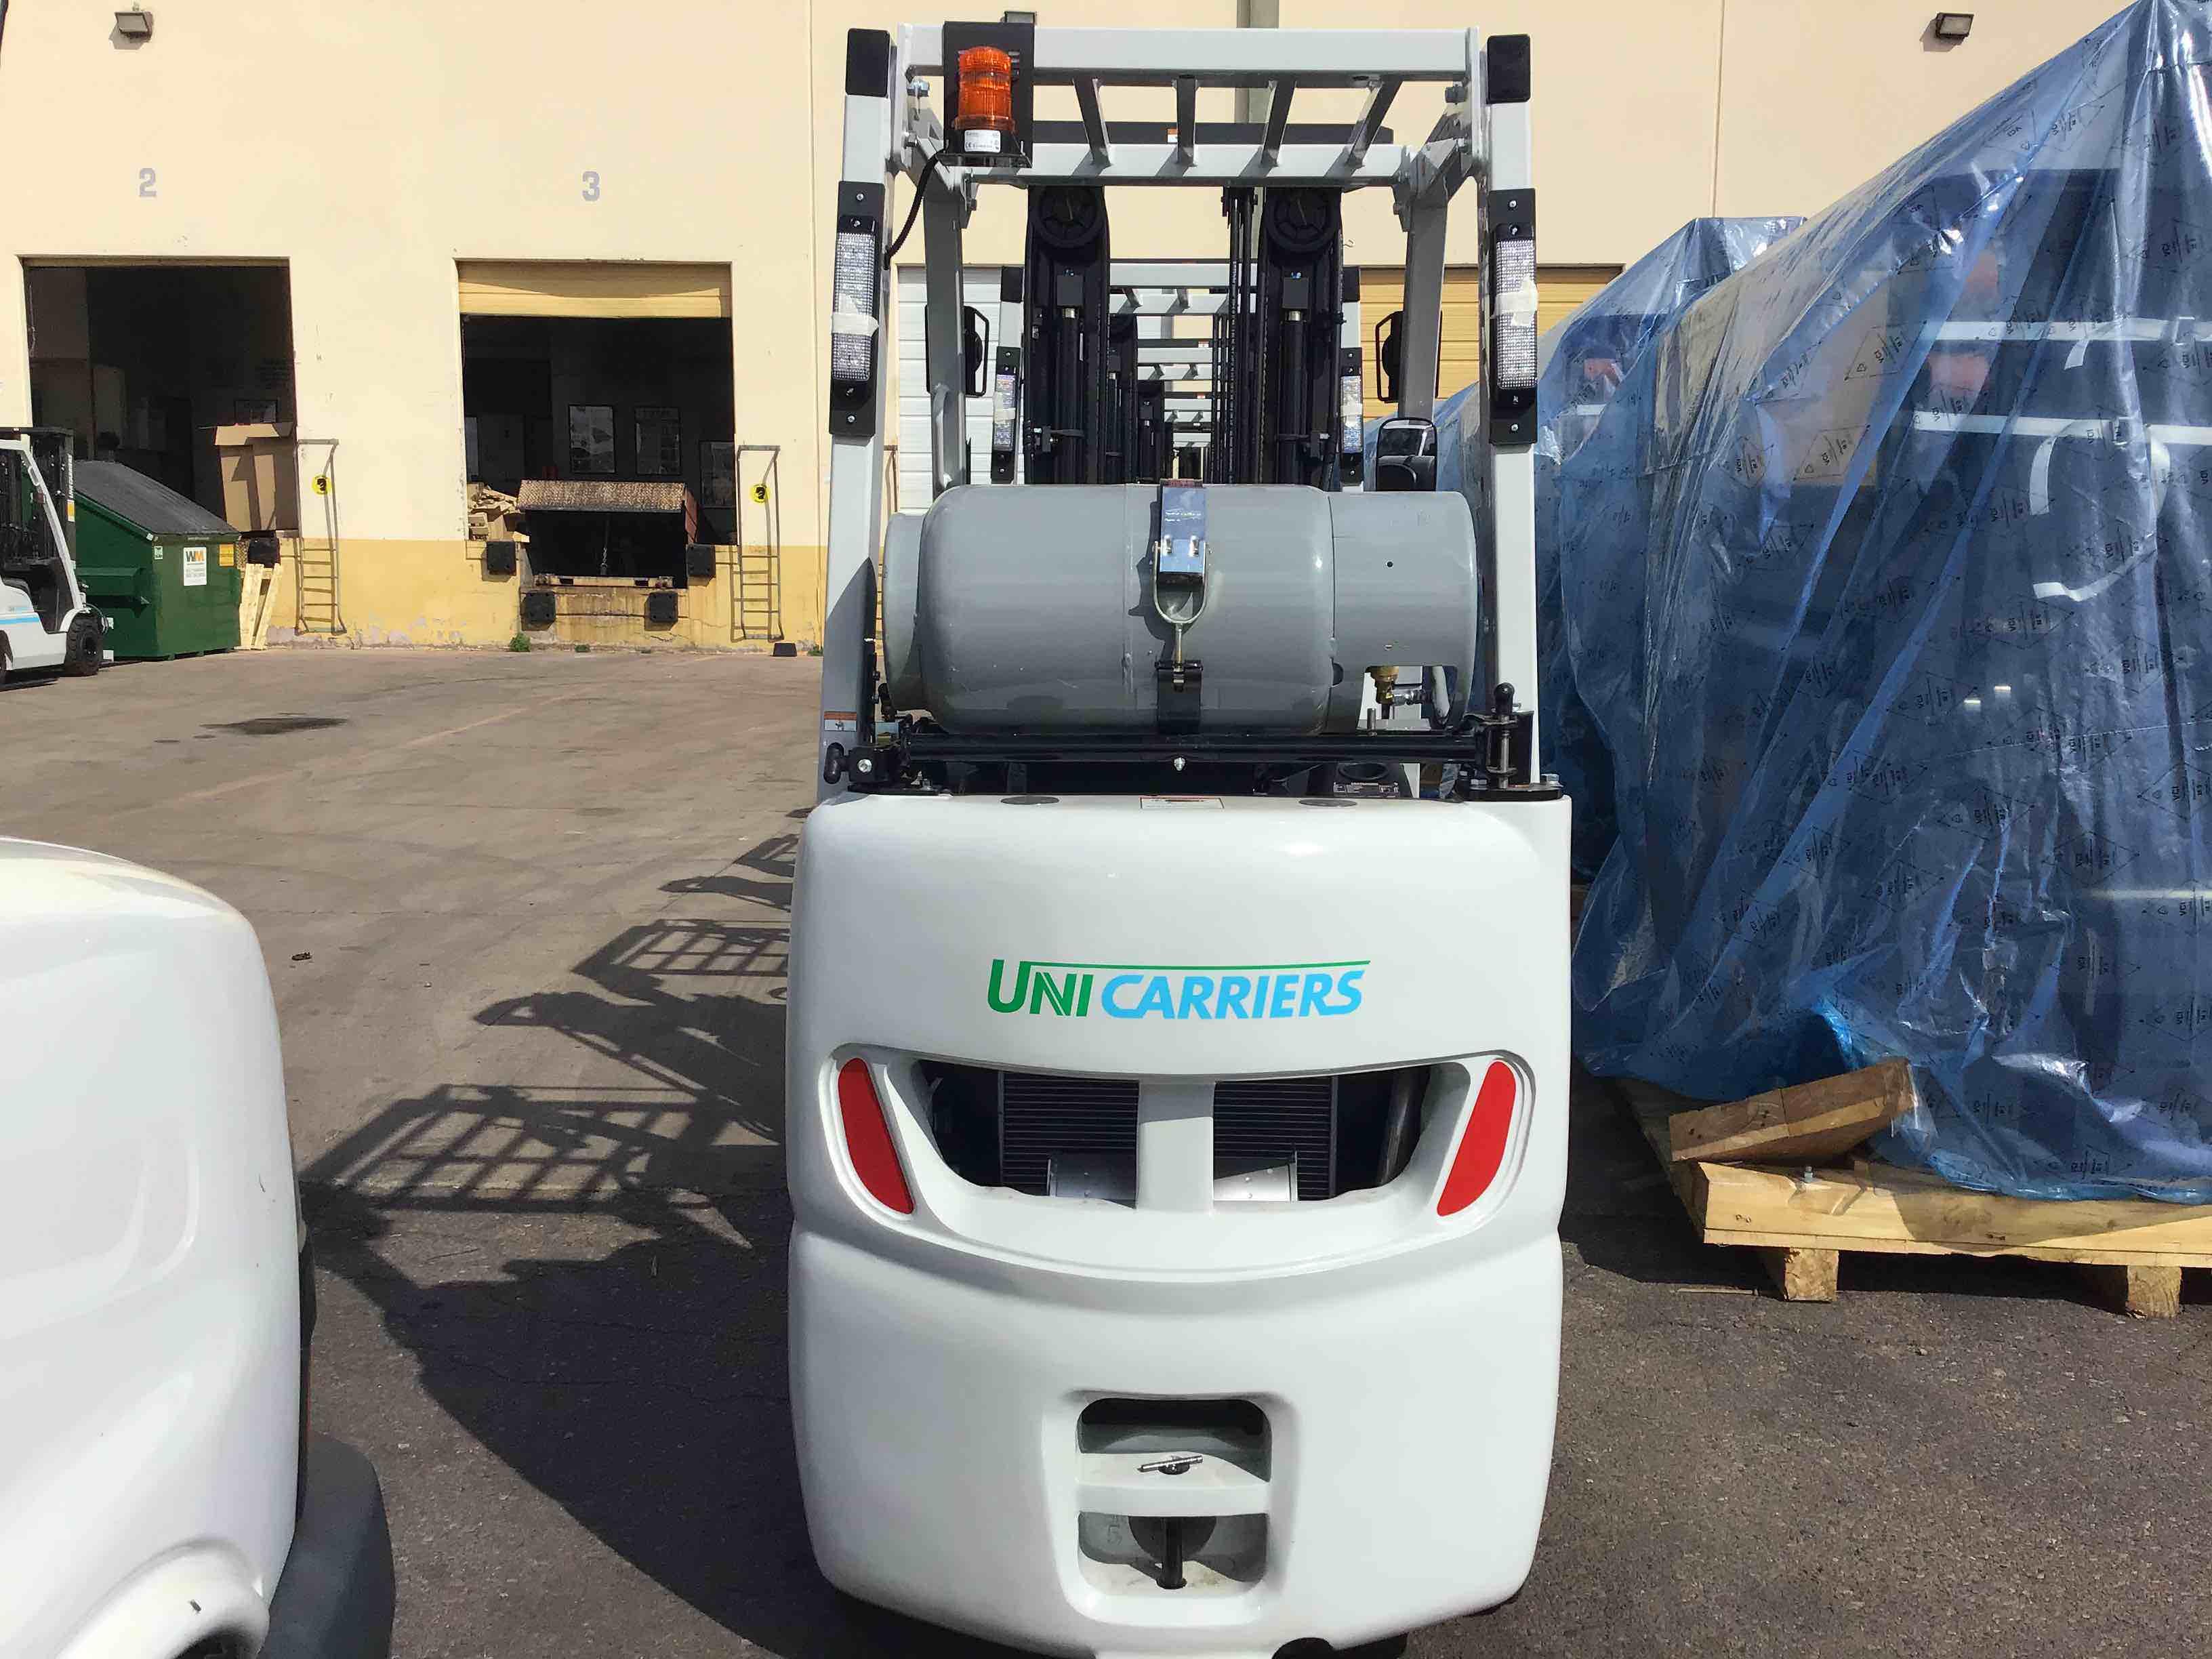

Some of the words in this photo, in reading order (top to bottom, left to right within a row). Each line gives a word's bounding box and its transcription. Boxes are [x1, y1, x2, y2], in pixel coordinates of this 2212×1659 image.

[139, 168, 157, 197] 2
[582, 171, 600, 201] 3
[1931, 407, 1941, 422] VCI
[1822, 452, 1830, 466] VCI
[2200, 470, 2209, 485] VCI
[186, 550, 205, 562] WM
[2171, 785, 2180, 801] VCI
